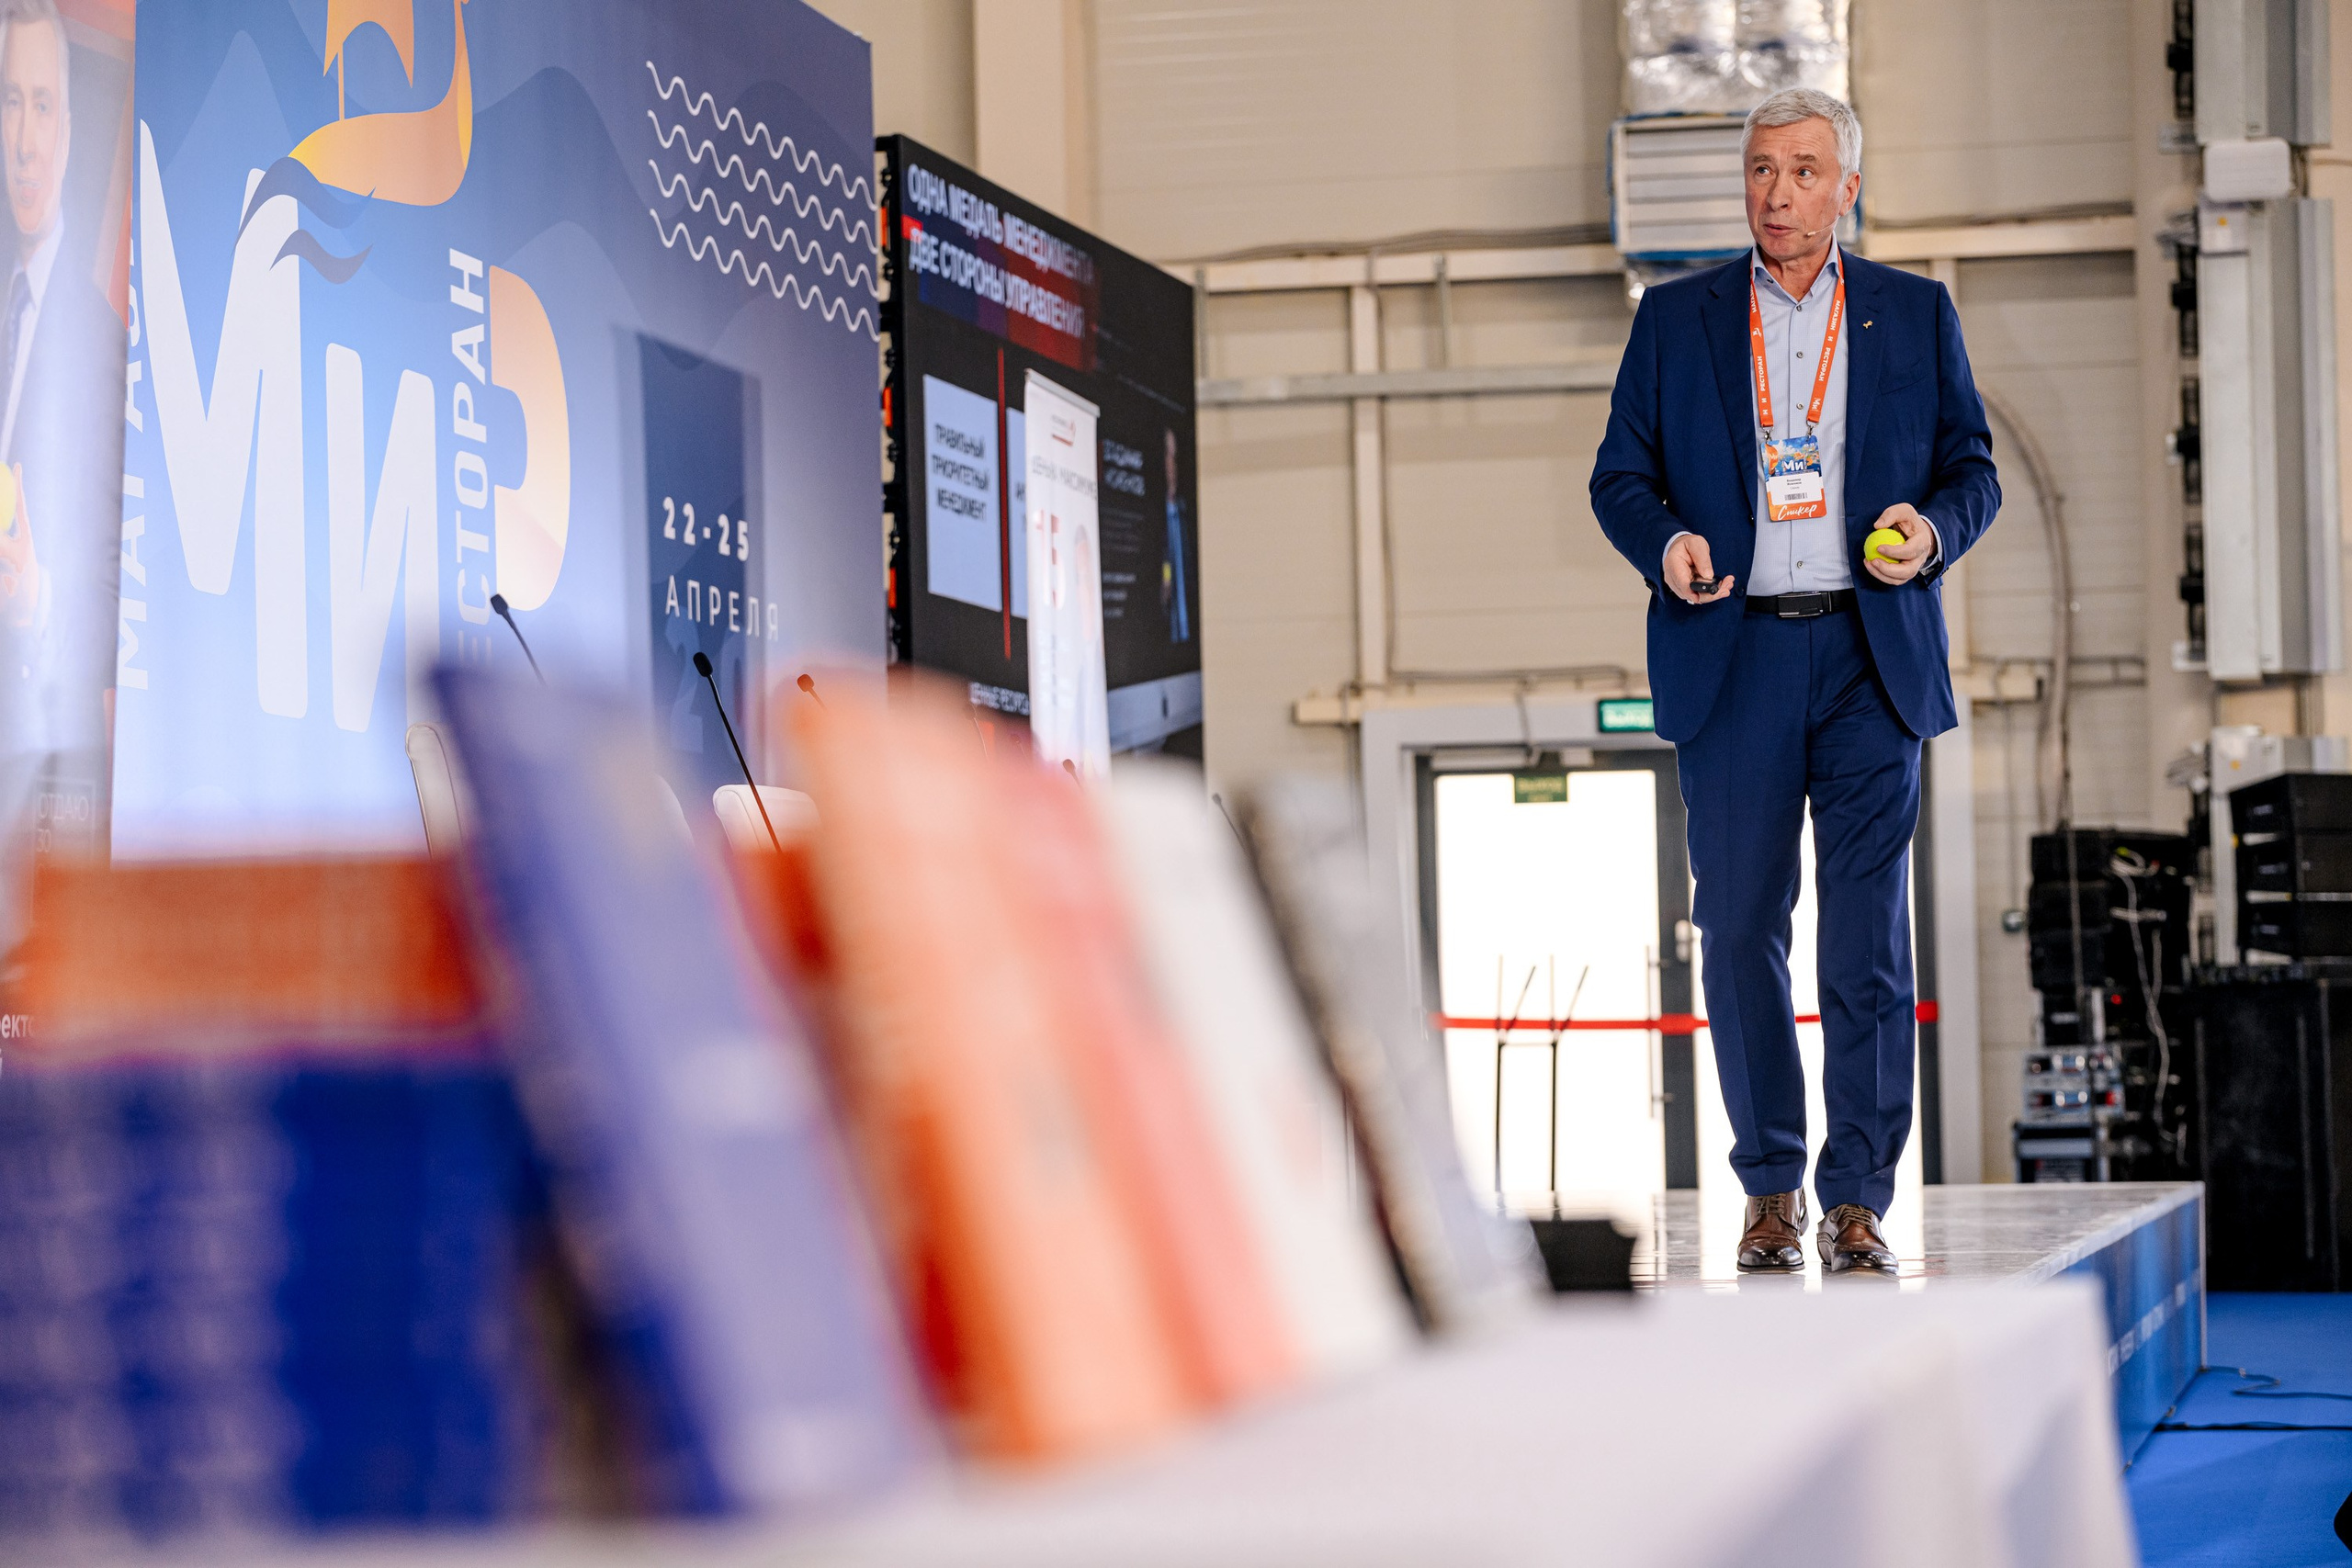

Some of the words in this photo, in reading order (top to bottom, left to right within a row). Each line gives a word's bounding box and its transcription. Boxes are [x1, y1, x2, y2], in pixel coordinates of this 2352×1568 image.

[908, 164, 949, 218] ОДНА
[948, 184, 1004, 244] МЕДАЛЬ
[909, 228, 940, 275] ДВЕ
[939, 241, 1005, 305] СТОРОНЫ
[1830, 299, 1841, 331] МАГАЗИН
[1757, 355, 1766, 392] РЕСТОРАН
[1818, 346, 1831, 382] РЕСТОРАН
[449, 247, 492, 669] ЕСТОРАН
[662, 496, 750, 562] 22-25
[1778, 504, 1817, 521] Спикер
[665, 575, 779, 642] АПРЕЛЯ
[40, 793, 90, 822] ОТДАЮ
